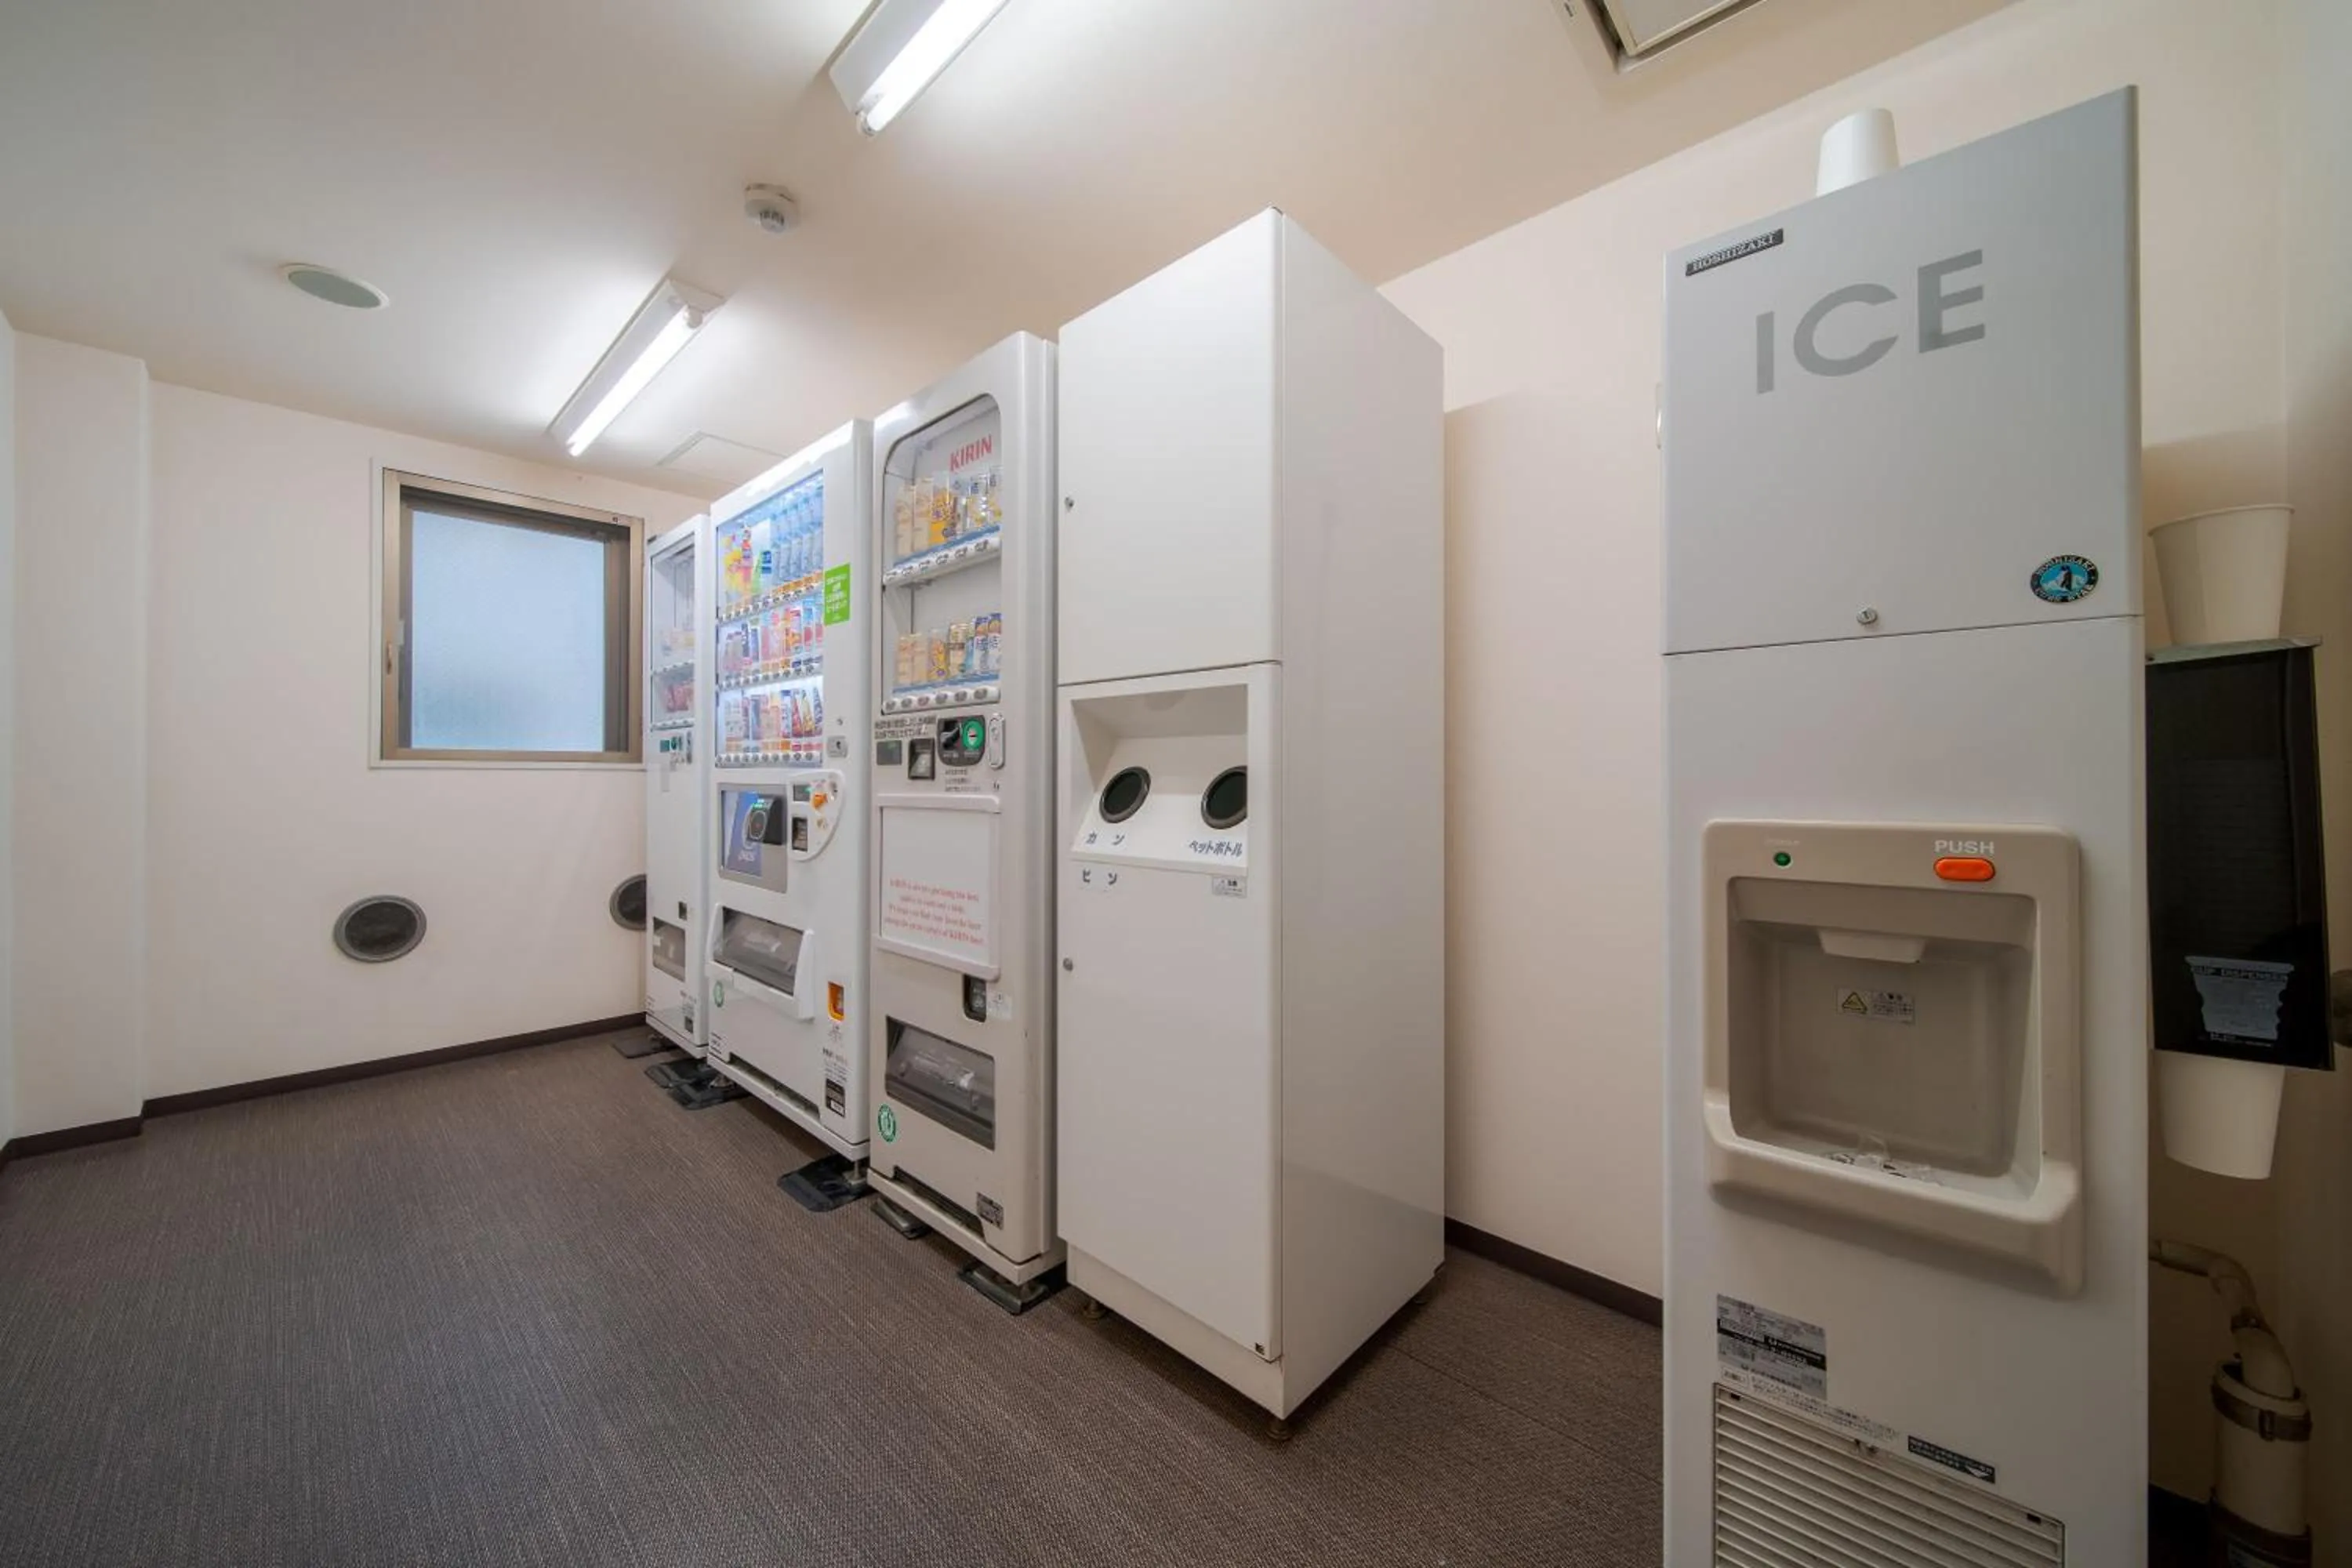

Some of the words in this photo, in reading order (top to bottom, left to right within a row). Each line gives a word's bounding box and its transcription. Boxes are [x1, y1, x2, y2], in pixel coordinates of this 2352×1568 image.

[1691, 230, 1777, 272] HOSHIZAKI
[1755, 249, 1985, 394] ICE
[949, 434, 993, 472] KIRIN
[1189, 840, 1243, 858] ペットボトル
[1933, 840, 1995, 855] PUSH
